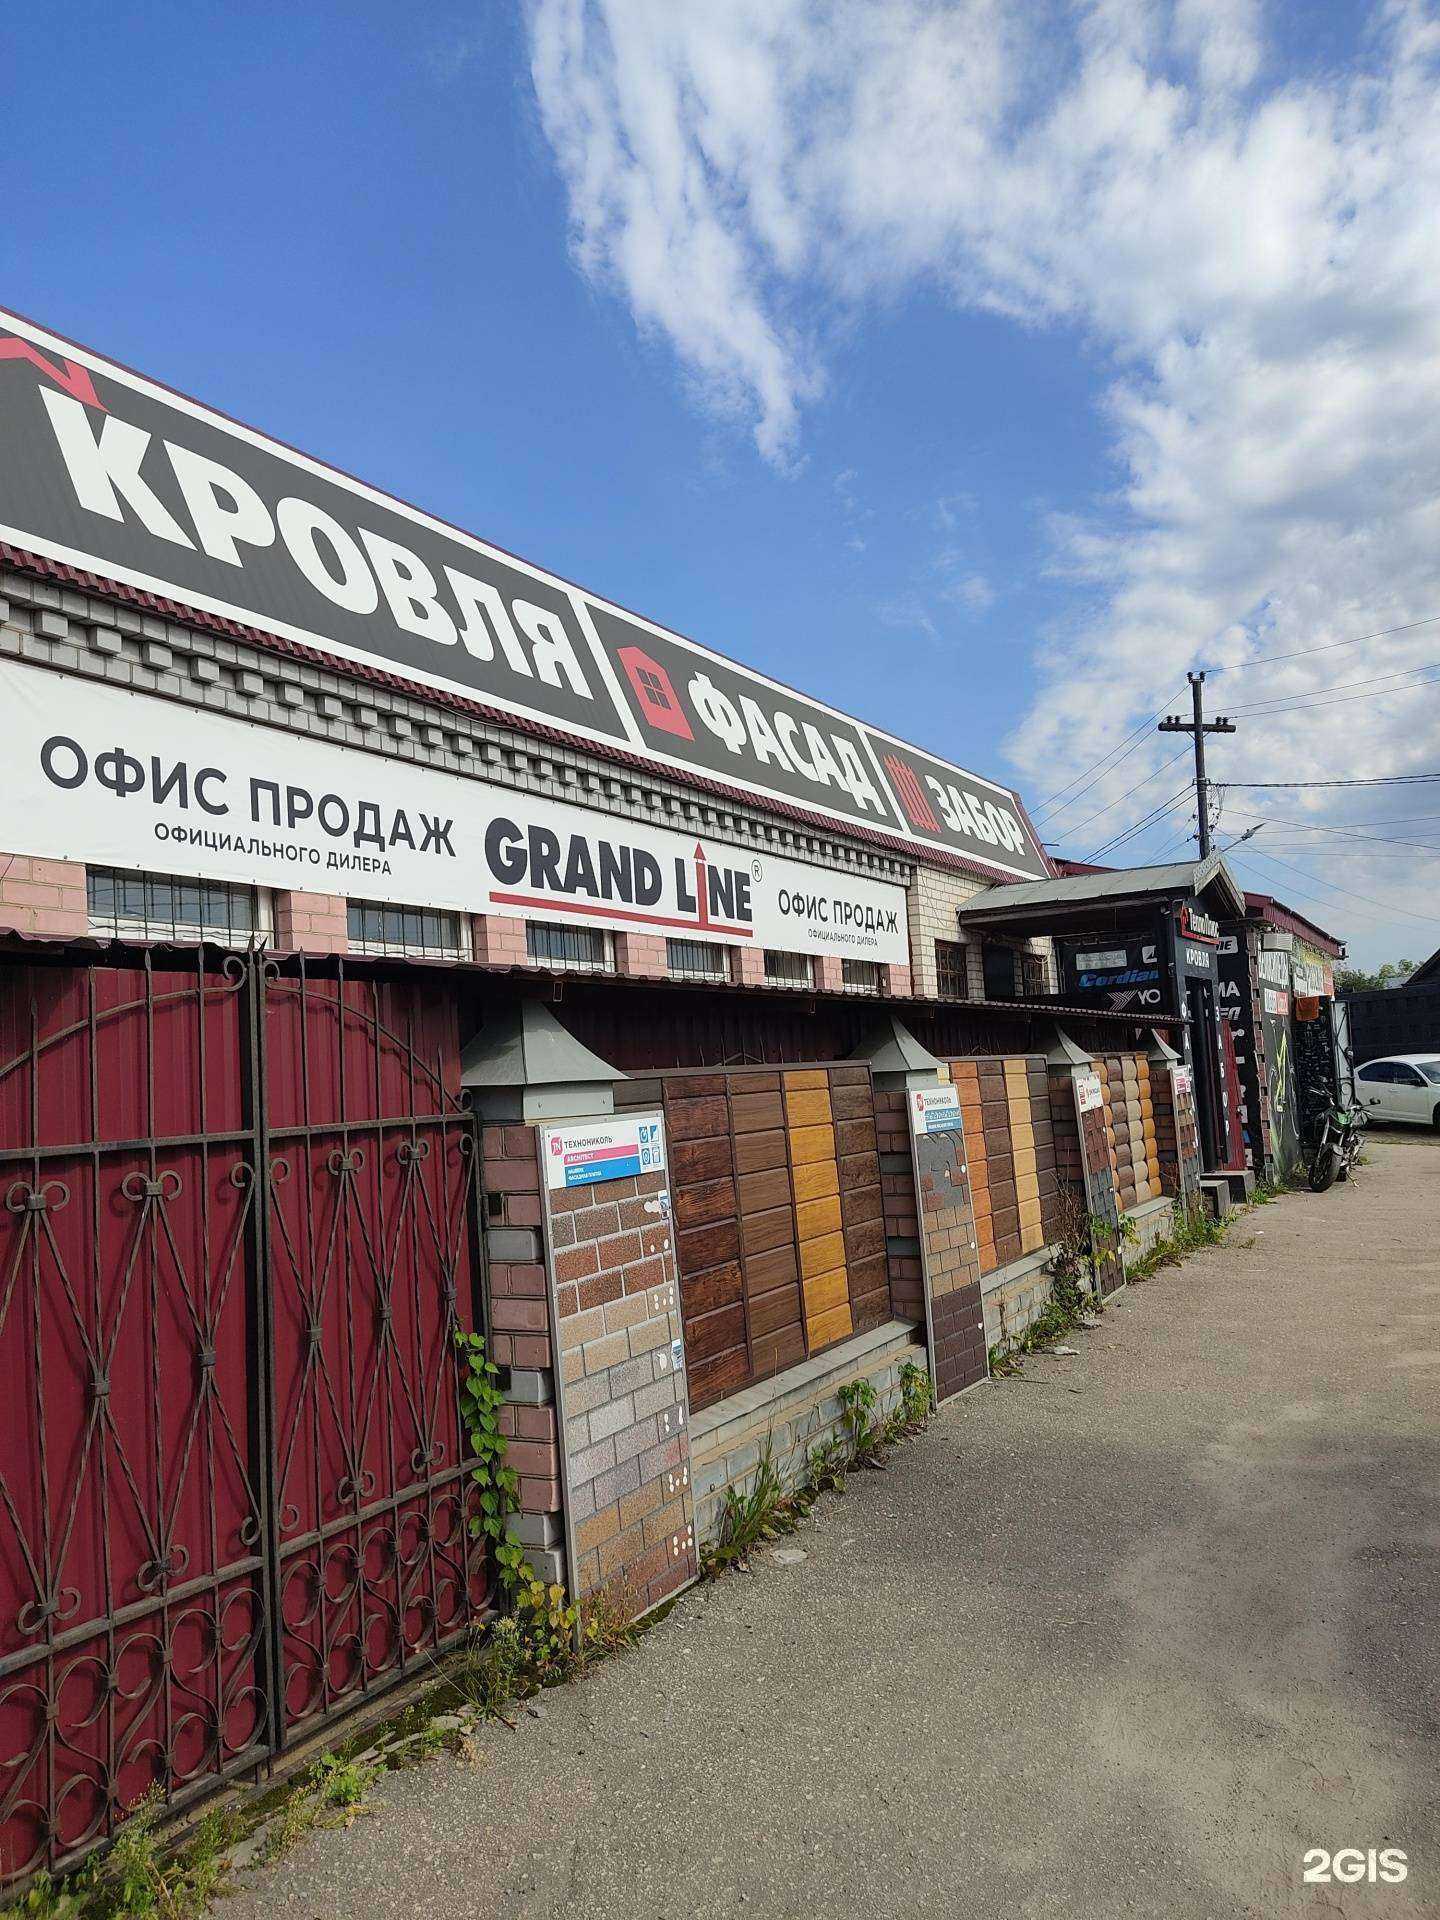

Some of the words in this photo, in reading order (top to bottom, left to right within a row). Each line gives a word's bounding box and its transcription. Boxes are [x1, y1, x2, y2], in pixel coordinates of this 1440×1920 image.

[39, 384, 594, 700] КРОВЛЯ
[688, 671, 888, 816] ФАСАД
[40, 735, 230, 816] ОФИС
[249, 777, 456, 858] ПРОДАЖ
[925, 775, 1026, 857] ЗАБОР
[154, 822, 322, 866] ОФИЦИАЛЬНОГО
[326, 852, 392, 876] ДИЛЕРА
[484, 817, 663, 906] GRAND
[675, 856, 753, 922] LINE
[778, 889, 828, 923] ОФИС
[833, 901, 899, 936] ПРОДАЖ
[807, 929, 857, 945] ОФИЦИАЛЬНОГО
[856, 933, 879, 948] ДИЛЕРА
[564, 1137, 613, 1149] ТЕХНОНИКОЛЬ
